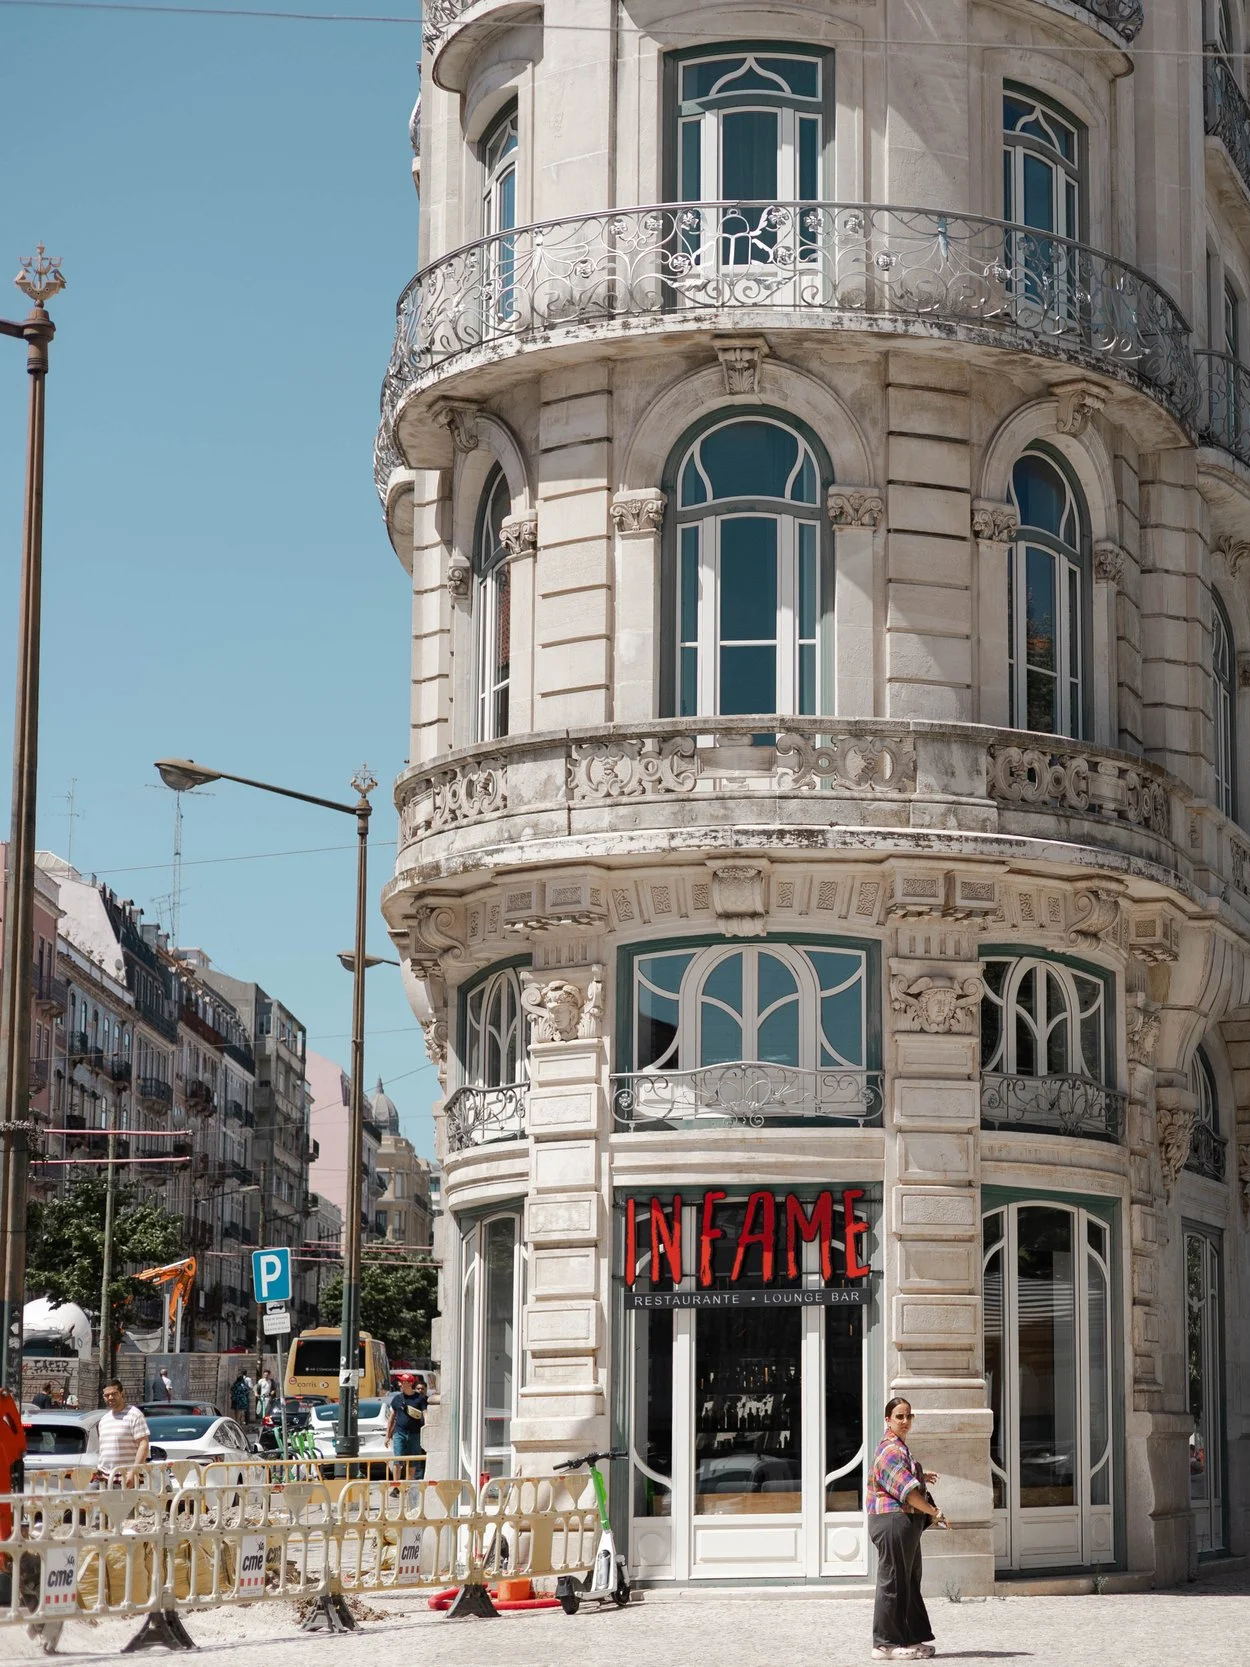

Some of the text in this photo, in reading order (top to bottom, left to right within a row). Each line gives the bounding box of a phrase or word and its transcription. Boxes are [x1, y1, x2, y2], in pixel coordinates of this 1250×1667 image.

[625, 1190, 871, 1287] INFAME
[260, 1254, 282, 1297] P
[634, 1291, 860, 1306] RESTAURANTE LOUNGE BAR
[401, 1545, 420, 1560] cme
[242, 1554, 264, 1572] cme
[47, 1569, 74, 1588] cme
